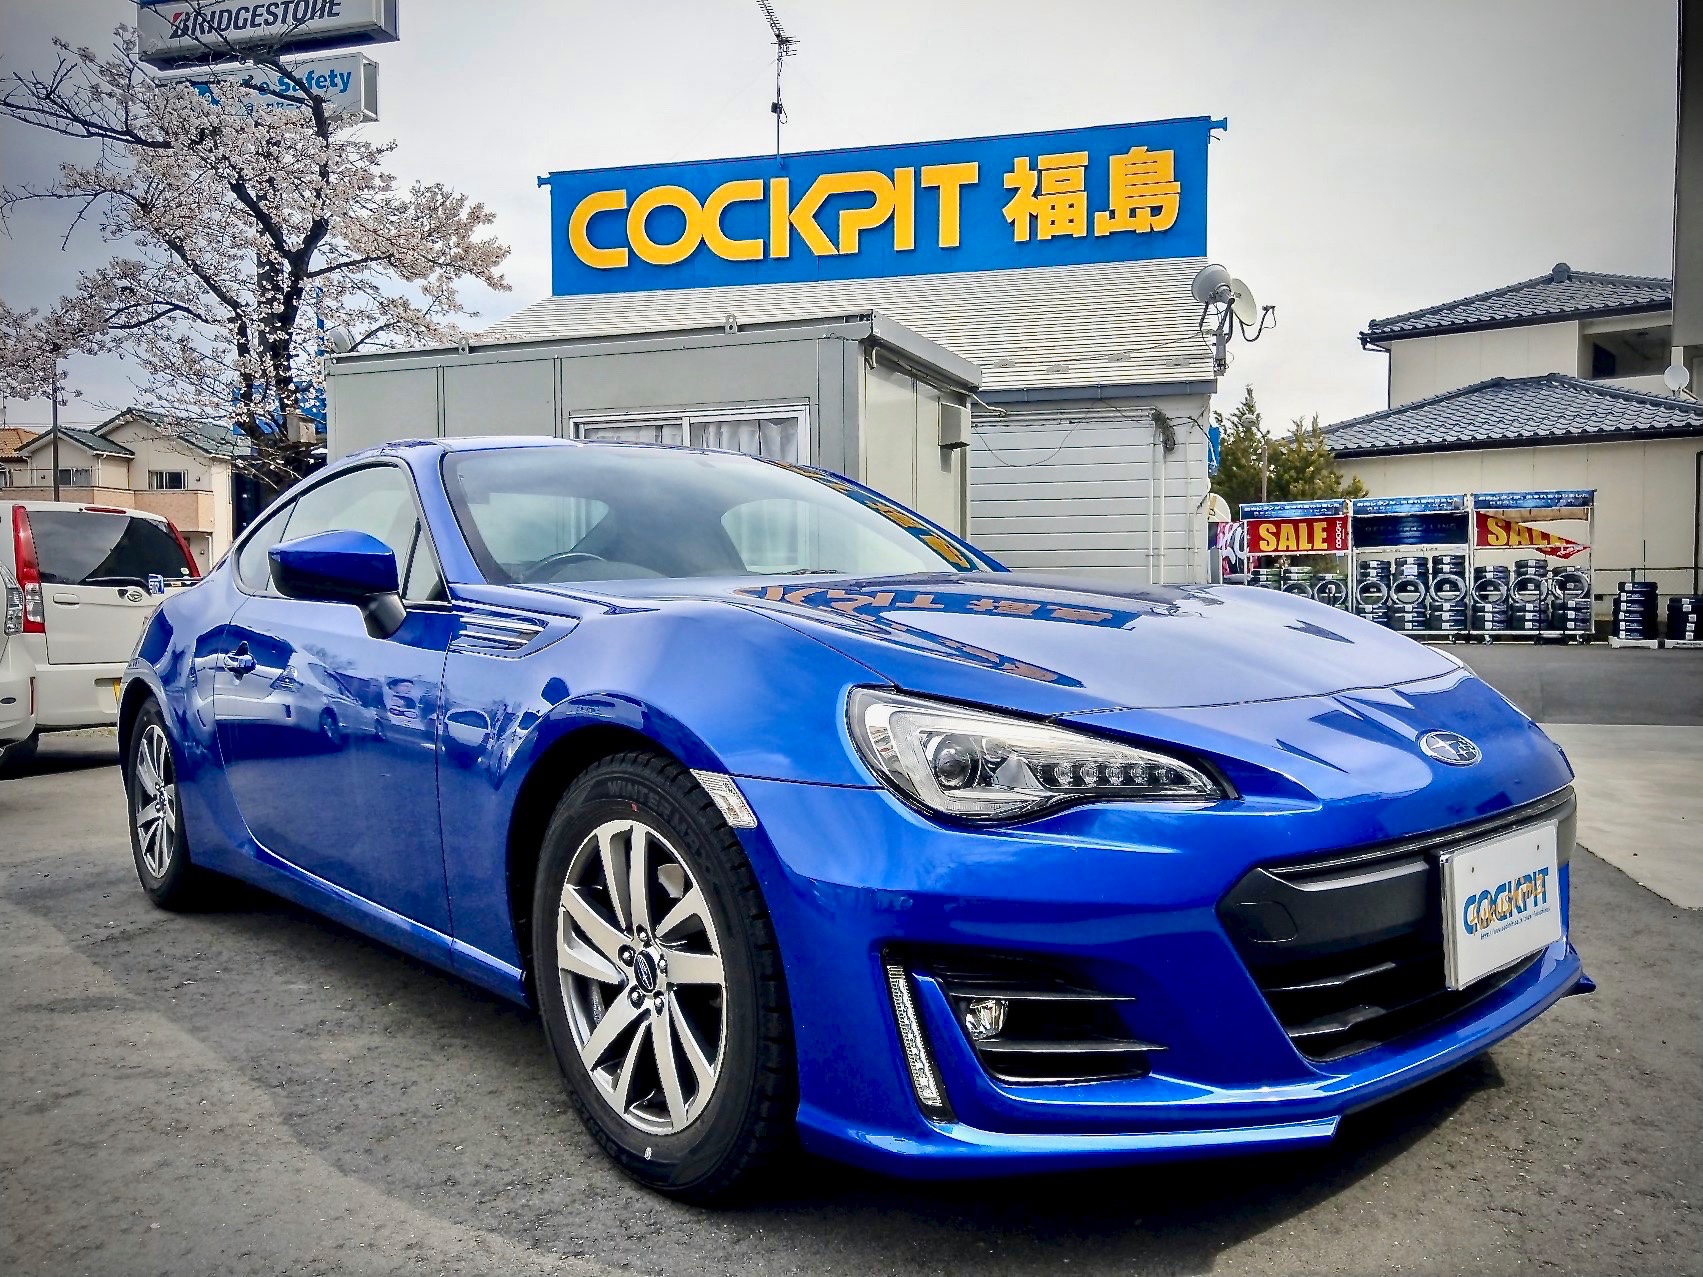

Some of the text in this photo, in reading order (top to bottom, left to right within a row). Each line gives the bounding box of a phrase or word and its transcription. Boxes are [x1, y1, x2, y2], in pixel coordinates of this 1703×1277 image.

[568, 146, 1182, 270] COCKPIT 福島
[1258, 521, 1328, 552] SALE
[1463, 866, 1549, 936] COCKPIT
